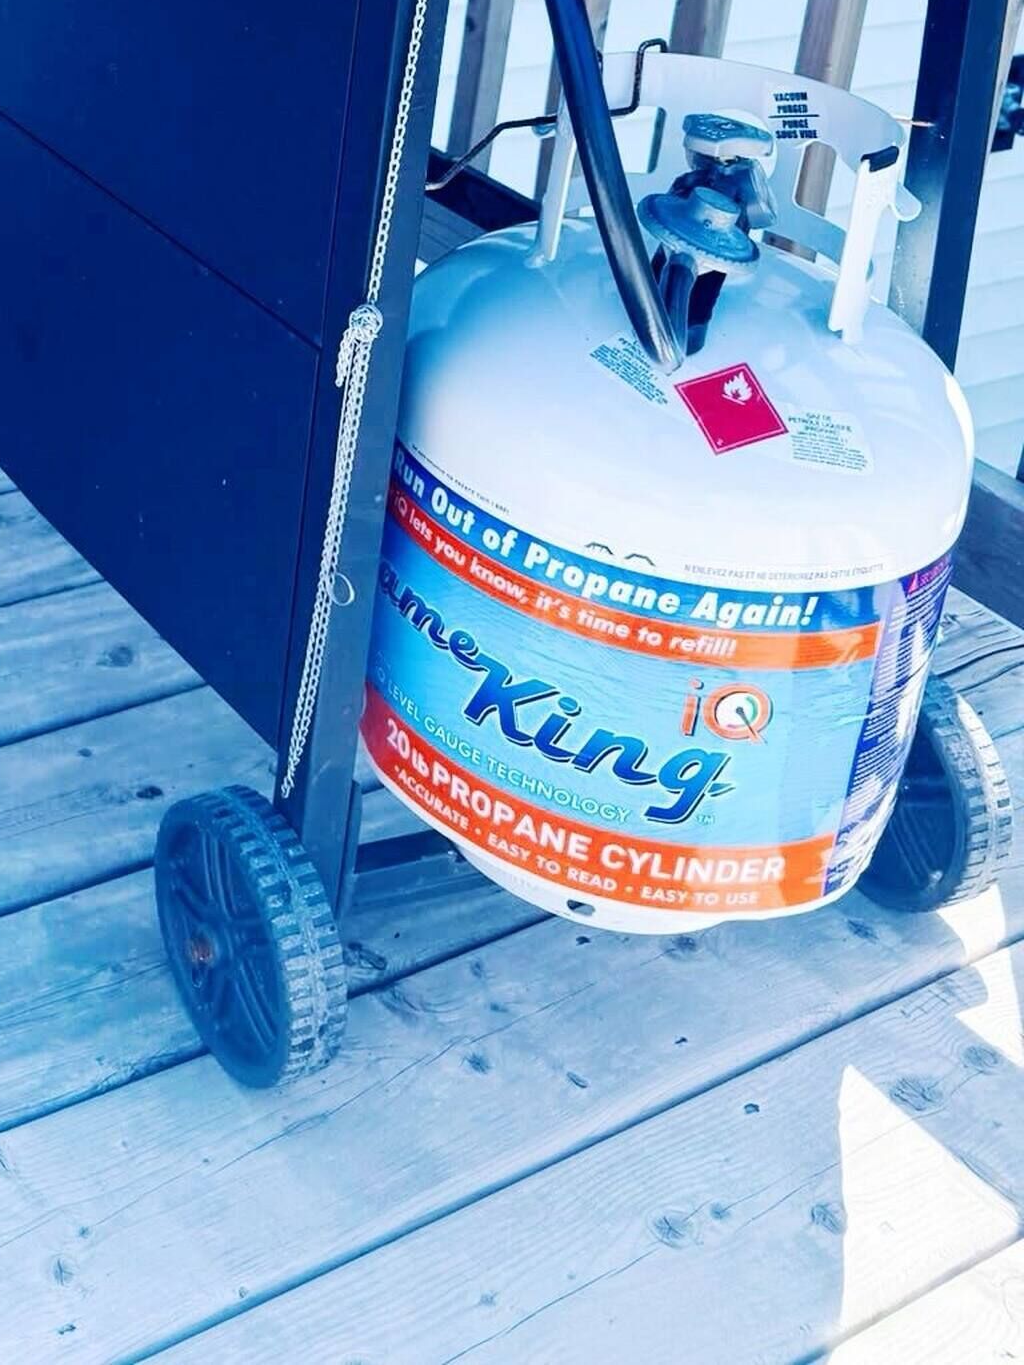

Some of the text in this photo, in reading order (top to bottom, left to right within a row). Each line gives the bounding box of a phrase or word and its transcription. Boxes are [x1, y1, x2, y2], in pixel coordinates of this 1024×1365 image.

[773, 91, 808, 102] VACUUM
[394, 446, 425, 499] Run
[432, 486, 475, 534] Out
[482, 528, 519, 558] of
[523, 541, 680, 615] Propane
[690, 591, 818, 629] Again!
[409, 508, 433, 542] lets
[434, 536, 466, 566] you
[470, 557, 528, 603] know,
[577, 610, 630, 638] time
[638, 626, 663, 646] to
[669, 637, 738, 658] refill!
[387, 679, 420, 722] LEVEL
[425, 717, 481, 764] GAUGE
[487, 756, 632, 824] TECHNOLOGY
[680, 676, 774, 746] iQ
[431, 761, 594, 862] PROPANE
[600, 844, 786, 885] CYLINDER
[487, 831, 531, 860] EASY
[536, 854, 561, 875] TO
[567, 866, 618, 892] READ
[640, 884, 687, 904] EASY
[693, 889, 721, 906] TO
[726, 890, 760, 906] USE
